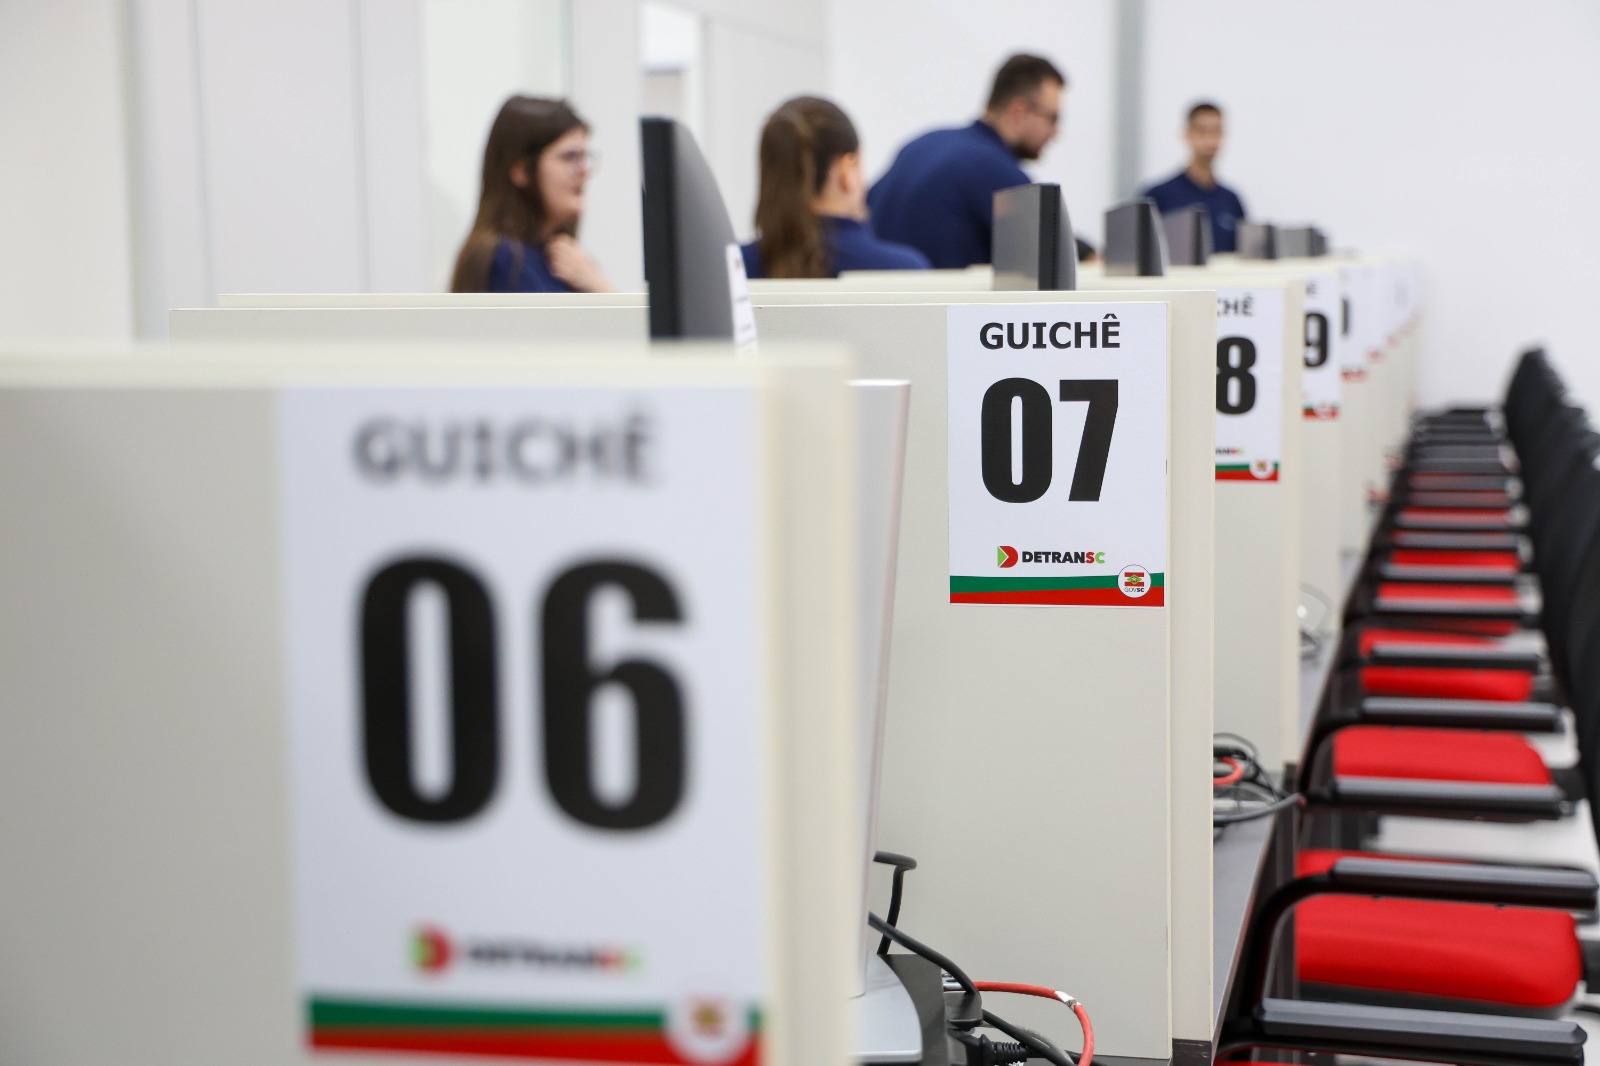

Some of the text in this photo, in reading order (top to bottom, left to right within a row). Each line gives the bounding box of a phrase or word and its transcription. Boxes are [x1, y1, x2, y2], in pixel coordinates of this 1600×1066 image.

[979, 313, 1121, 350] GUICHÊ
[352, 404, 656, 483] GUICHÊ
[980, 377, 1119, 504] 07
[1021, 550, 1106, 564] DETRANSC
[350, 547, 694, 840] 06
